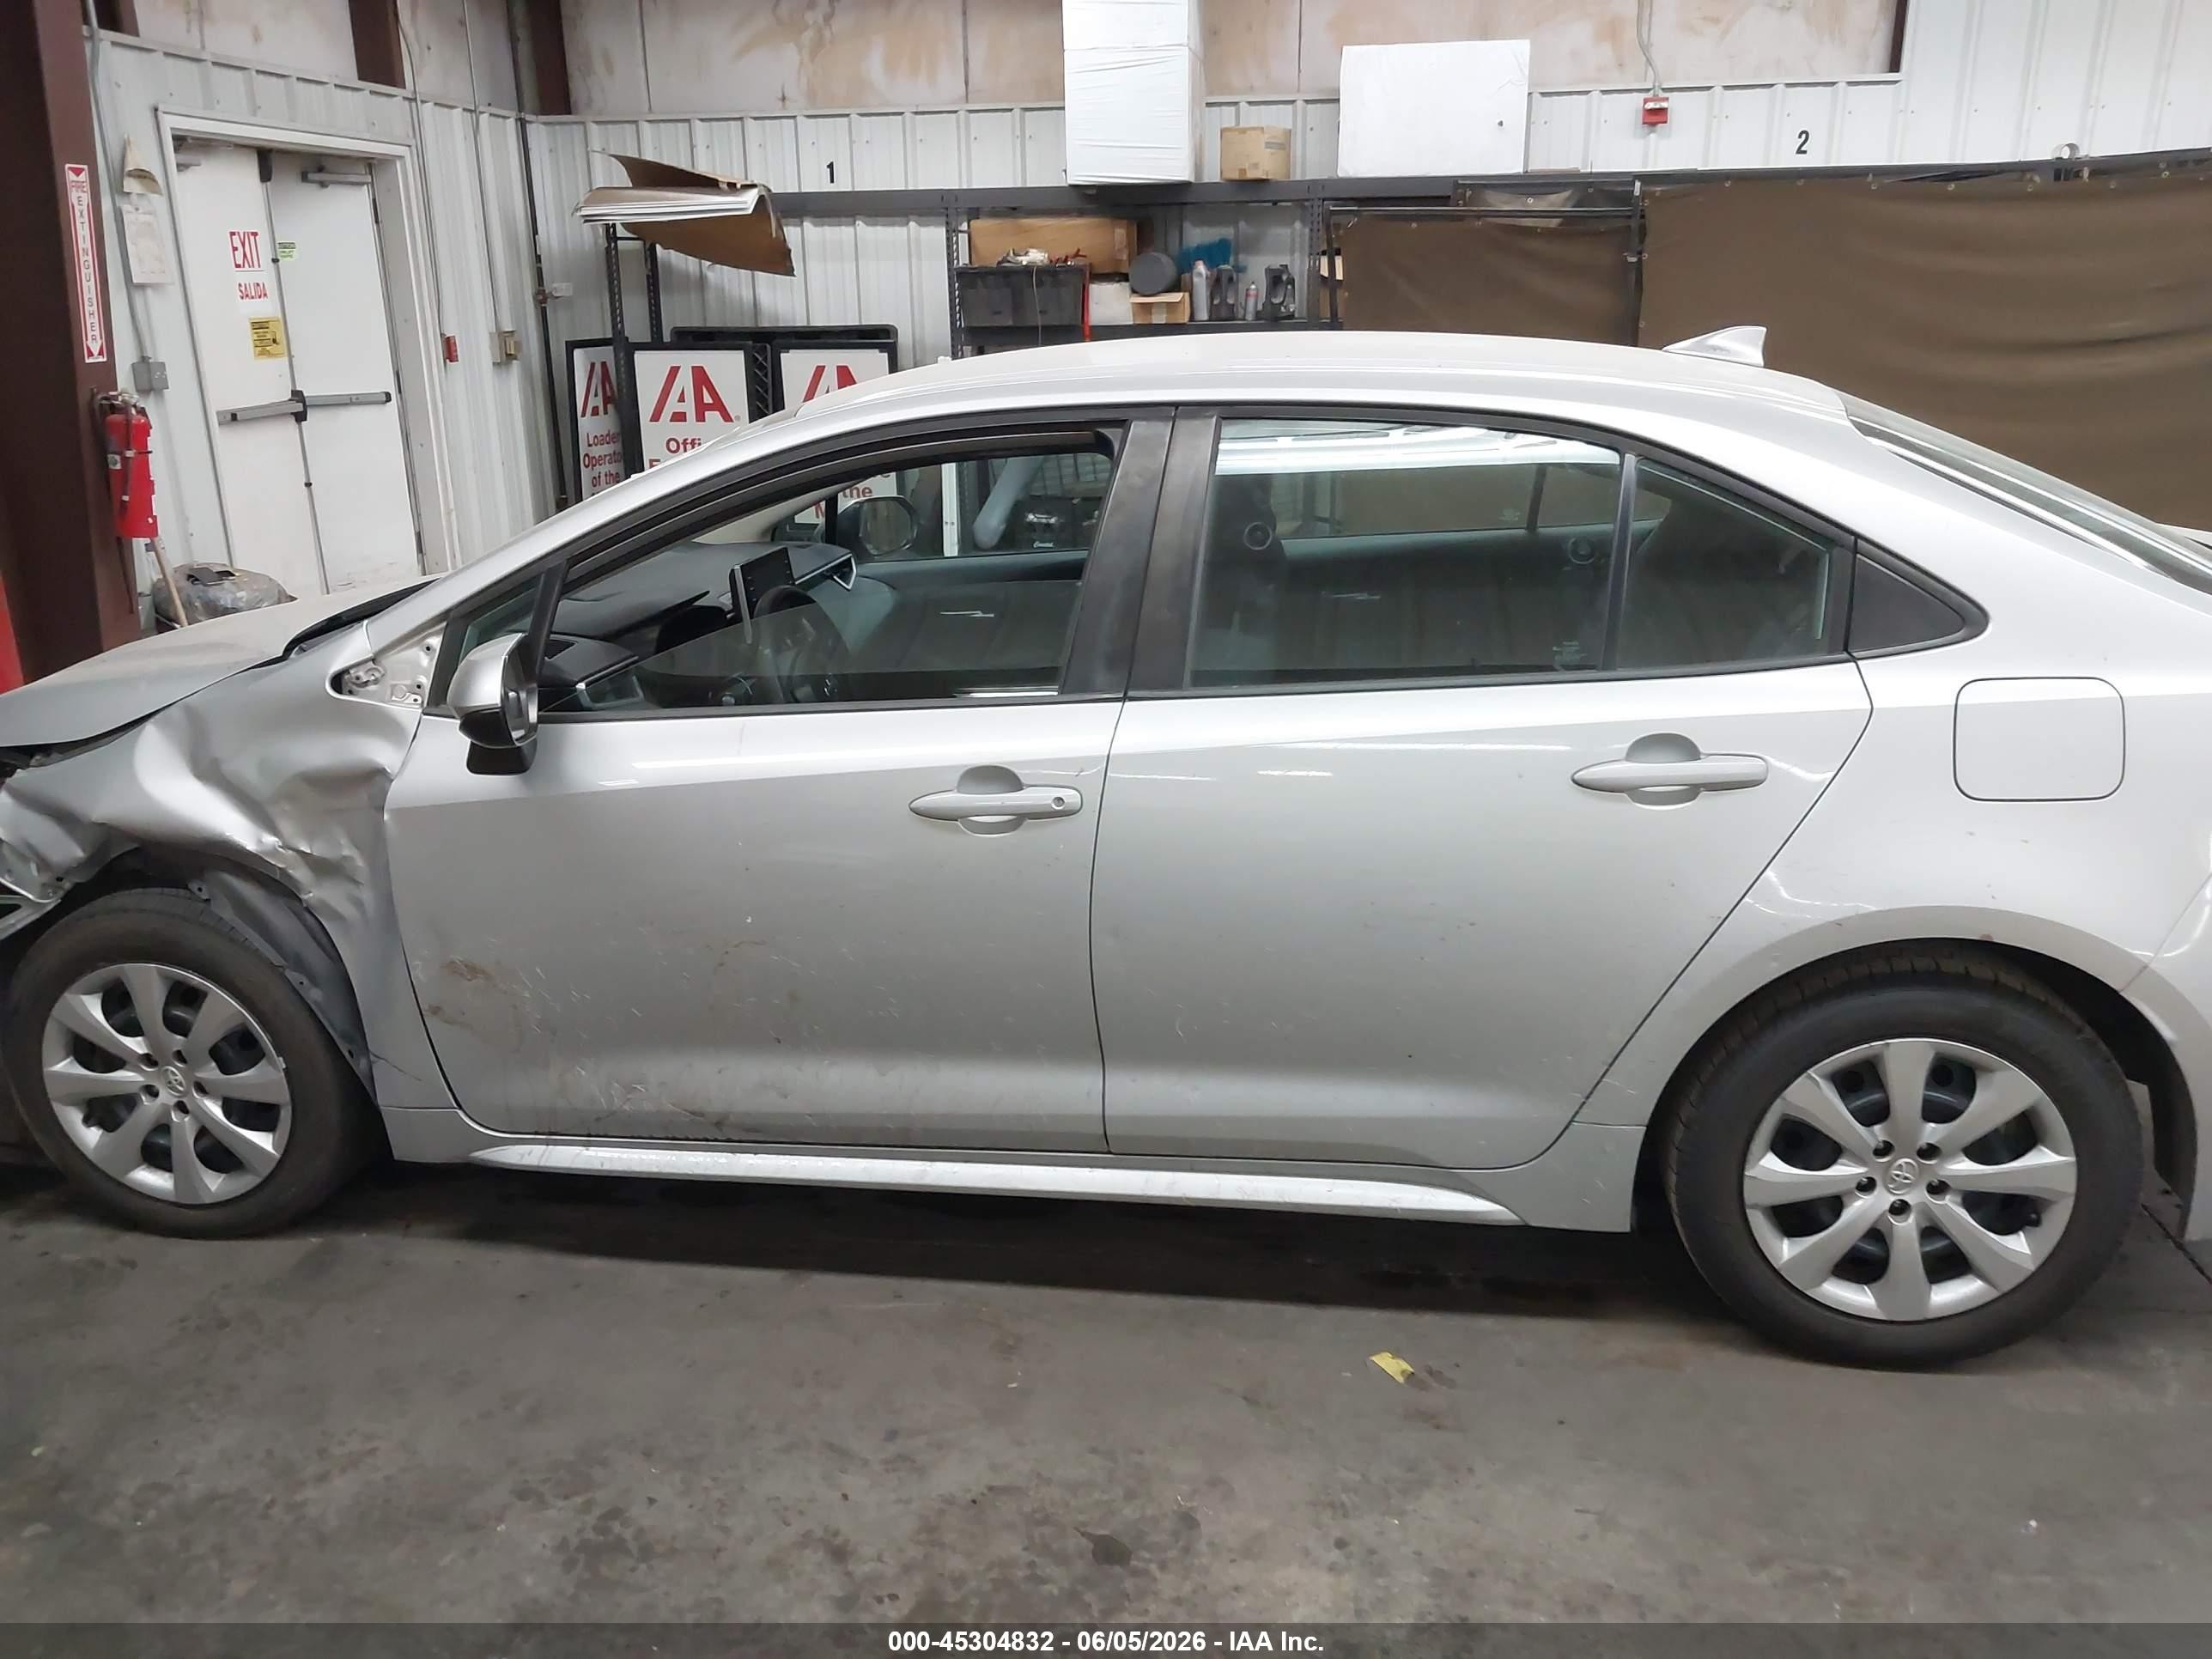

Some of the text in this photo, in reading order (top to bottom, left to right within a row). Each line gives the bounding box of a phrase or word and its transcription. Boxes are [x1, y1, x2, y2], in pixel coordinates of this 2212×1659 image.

[1796, 130, 1809, 155] 2
[826, 161, 835, 184] 1
[229, 231, 261, 269] EXIT
[77, 196, 97, 343] EXTINGUISHER
[238, 282, 269, 300] SALIDA
[583, 450, 623, 471] Operato
[591, 470, 620, 488] of the
